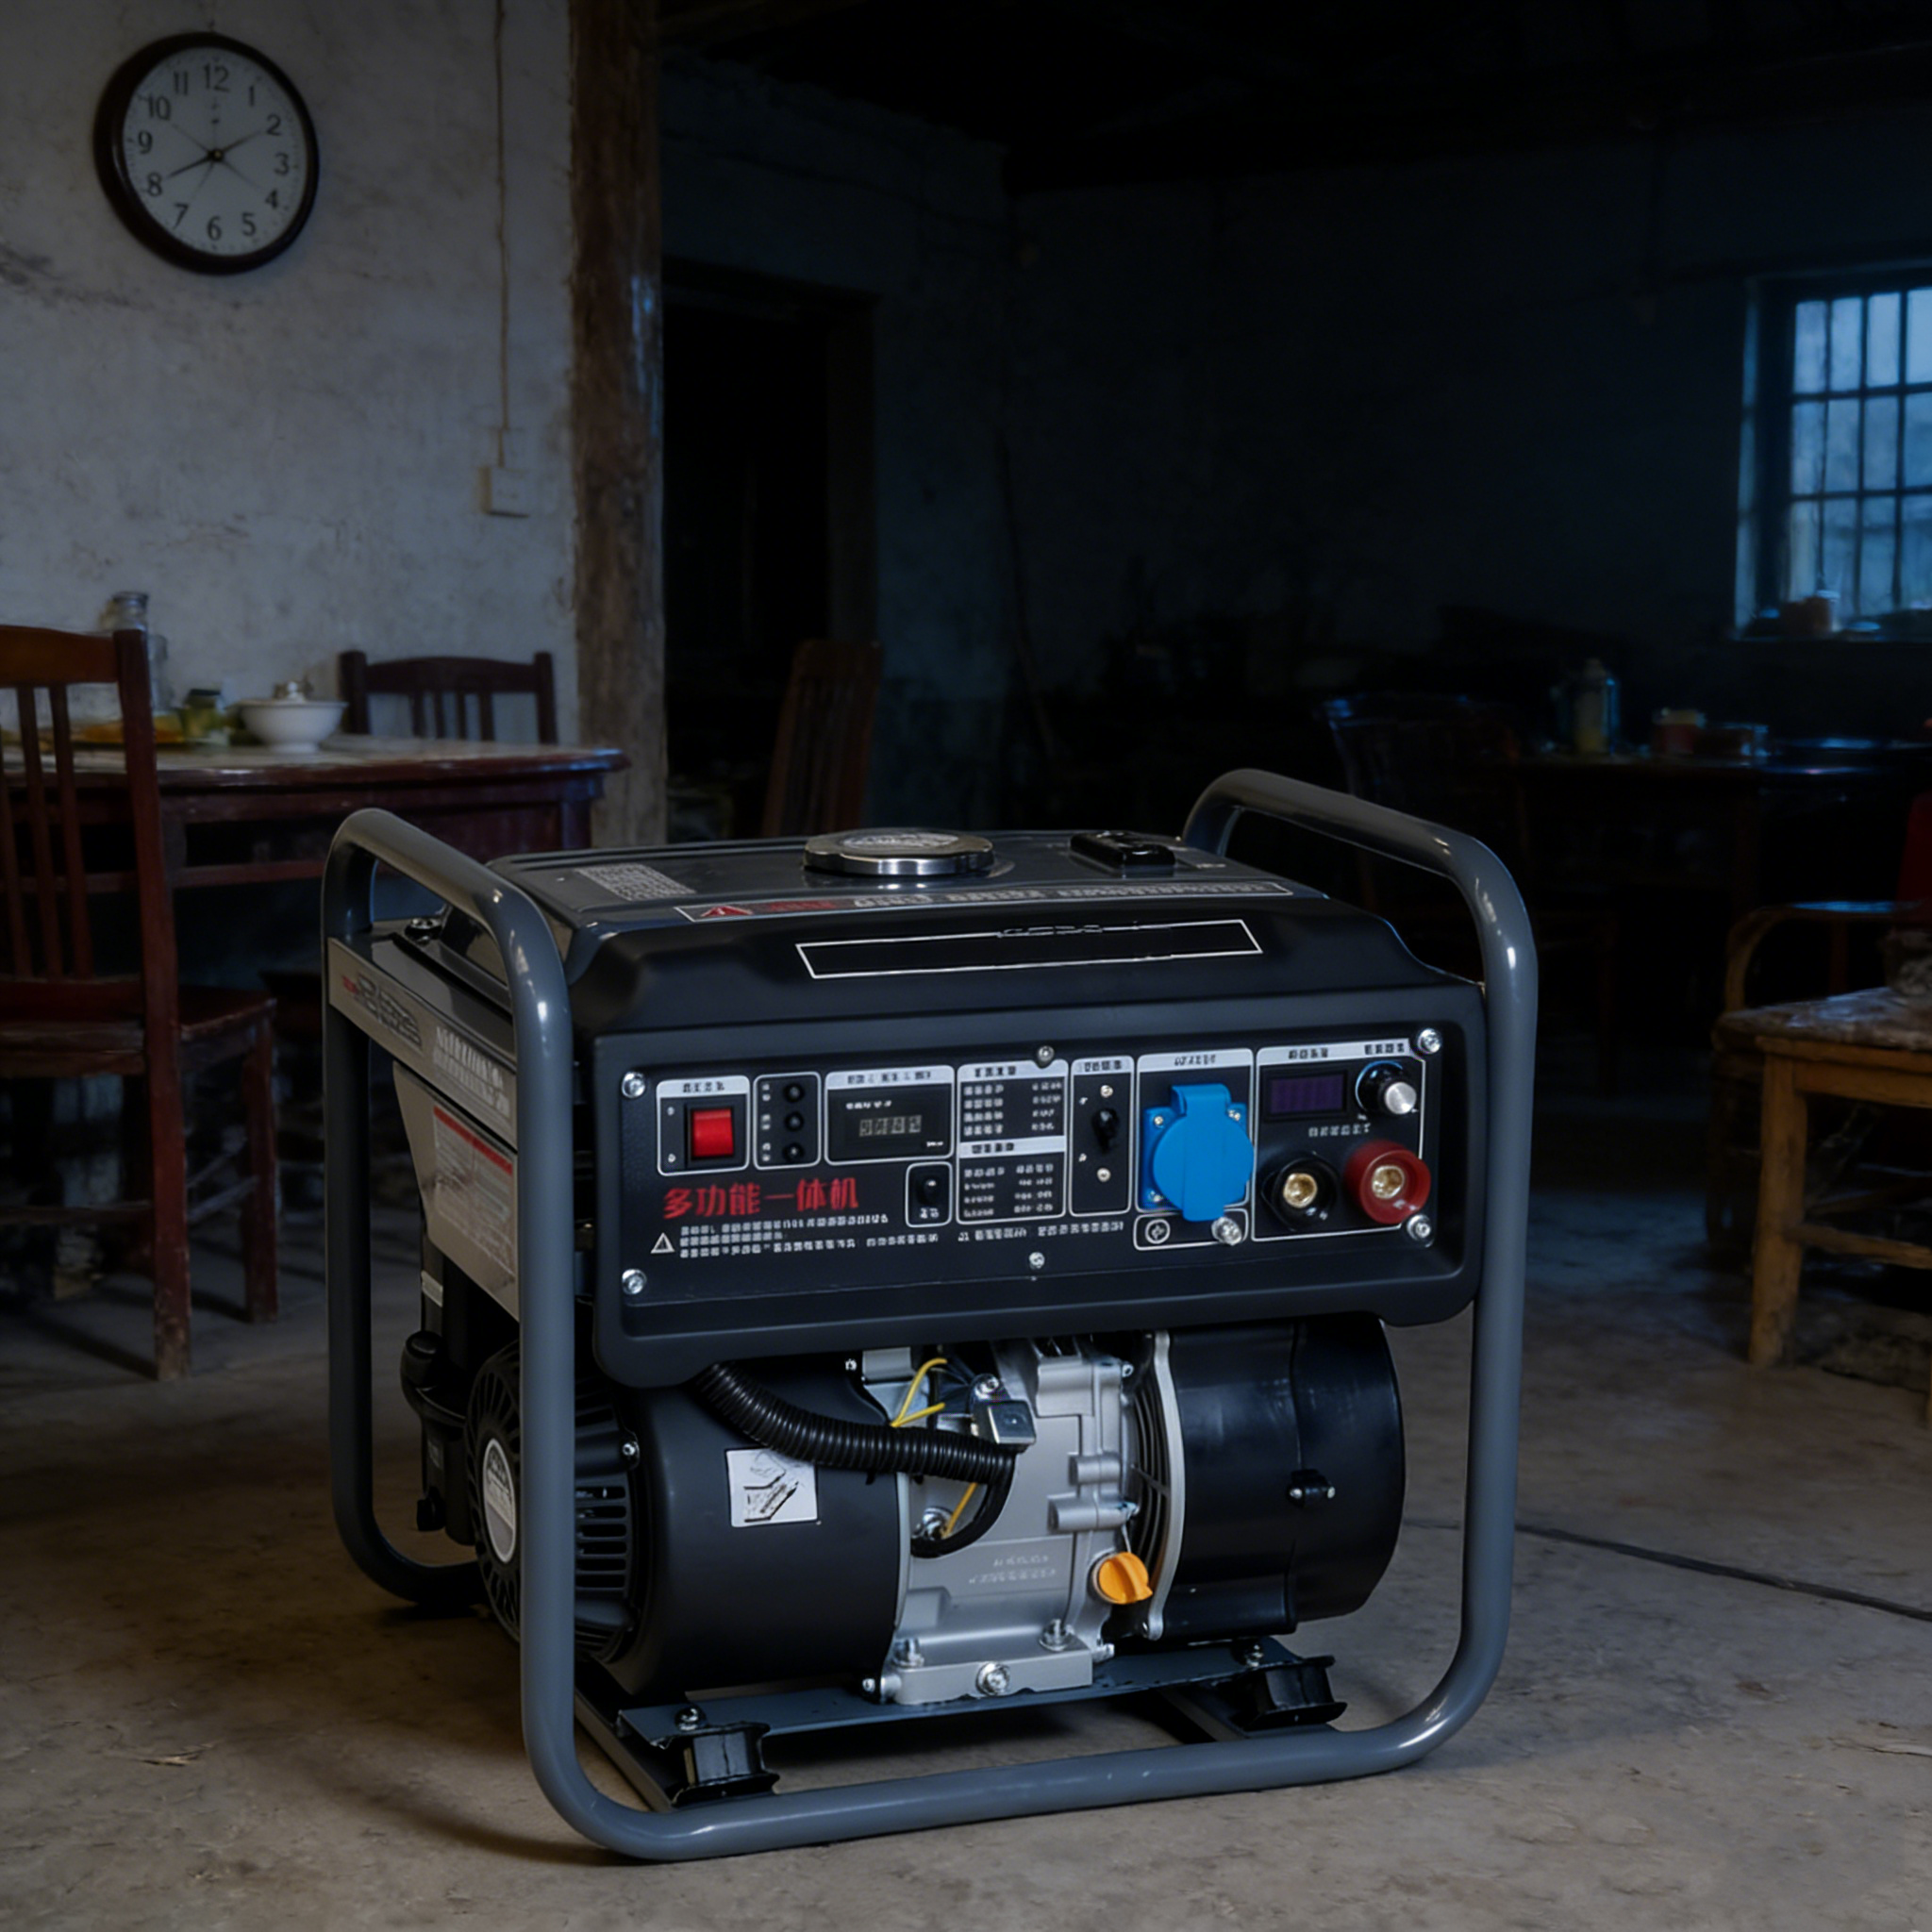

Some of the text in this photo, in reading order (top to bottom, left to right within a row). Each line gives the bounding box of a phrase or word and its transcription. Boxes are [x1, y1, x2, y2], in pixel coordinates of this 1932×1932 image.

[174, 71, 189, 95] 11
[204, 63, 229, 92] 12
[146, 95, 171, 121] 10
[248, 85, 255, 107] 1
[266, 114, 281, 136] 2
[138, 130, 153, 154] 9
[274, 152, 289, 175] 3
[147, 173, 162, 196] 8
[265, 190, 278, 209] 4
[175, 203, 189, 229] 7
[242, 213, 256, 236] 5
[207, 216, 222, 241] 6
[663, 1177, 859, 1219] 多功能一体机
